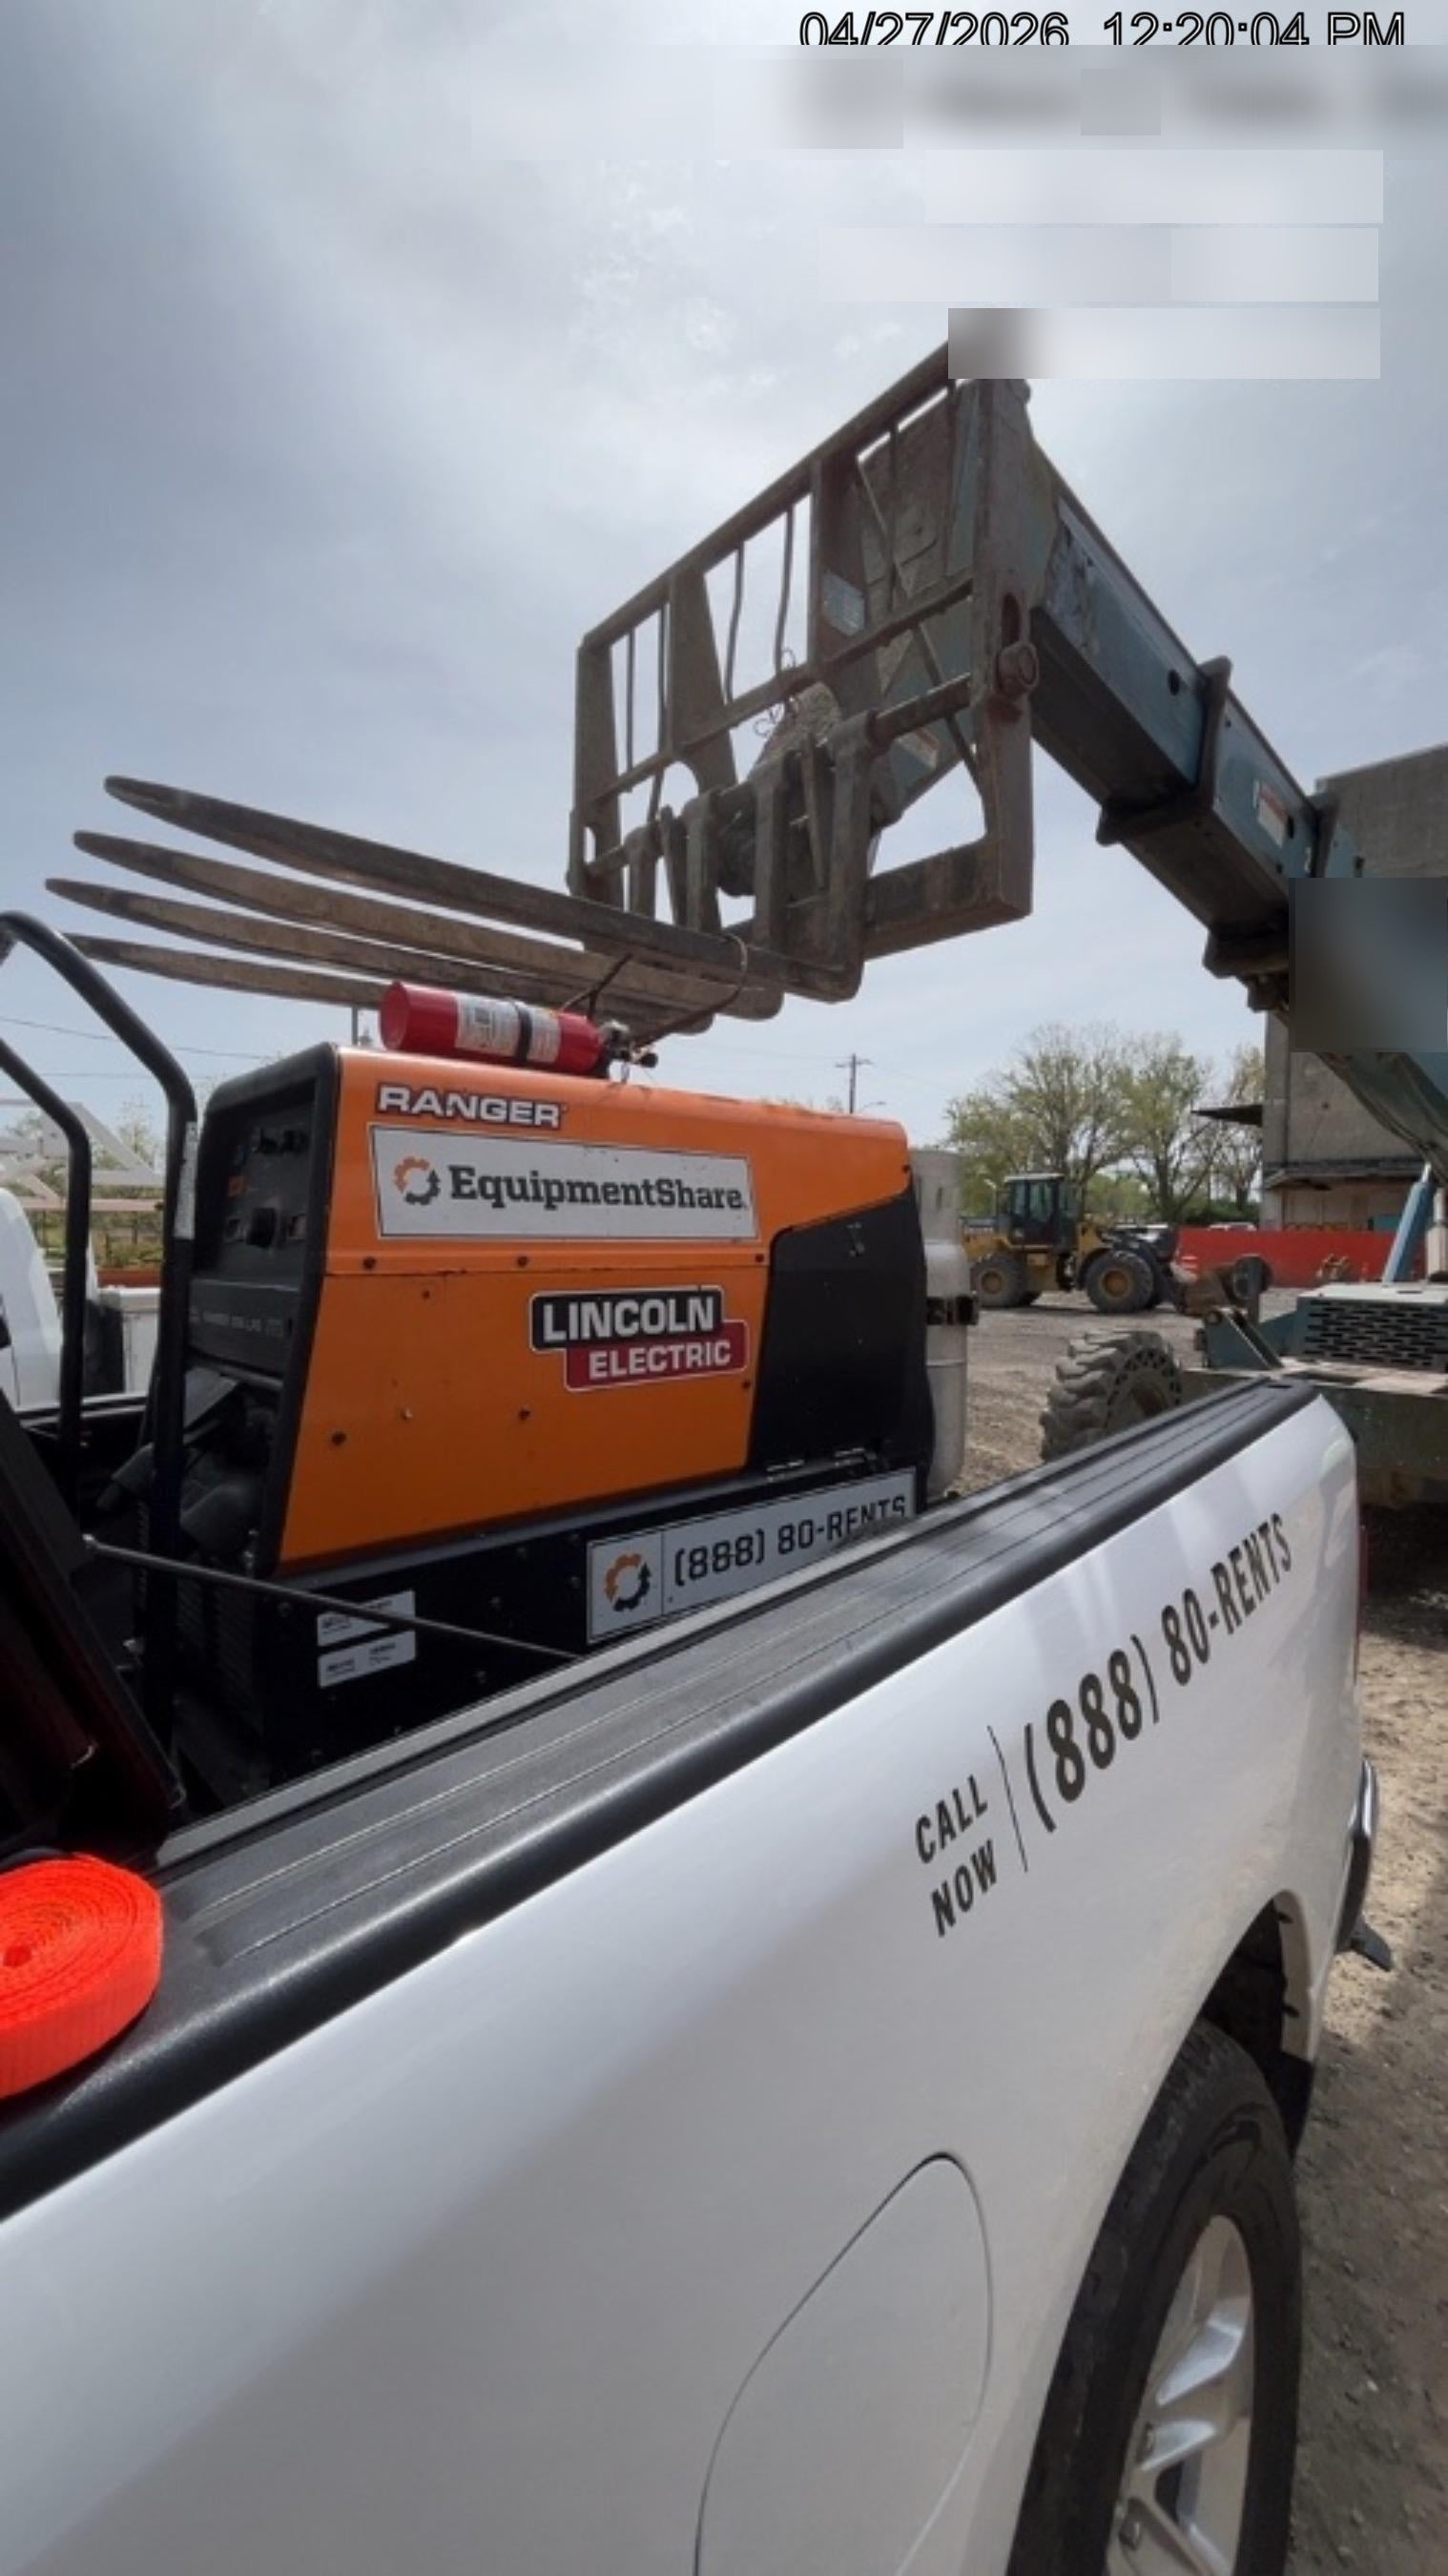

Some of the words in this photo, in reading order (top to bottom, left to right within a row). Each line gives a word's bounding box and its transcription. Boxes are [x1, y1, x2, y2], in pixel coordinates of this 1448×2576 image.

[378, 1085, 561, 1129] RANGER
[448, 1165, 747, 1212] EquipmentShare
[542, 1297, 714, 1341] LINCOLN
[588, 1340, 732, 1381] ELECTRIC
[673, 1528, 766, 1587] (888)
[777, 1495, 906, 1555] 80-RENTS
[1024, 1633, 1161, 1834] (888)
[1160, 1512, 1293, 1687] 80-RENTS
[915, 1774, 989, 1864] CALL
[930, 1839, 998, 1939] NOW
